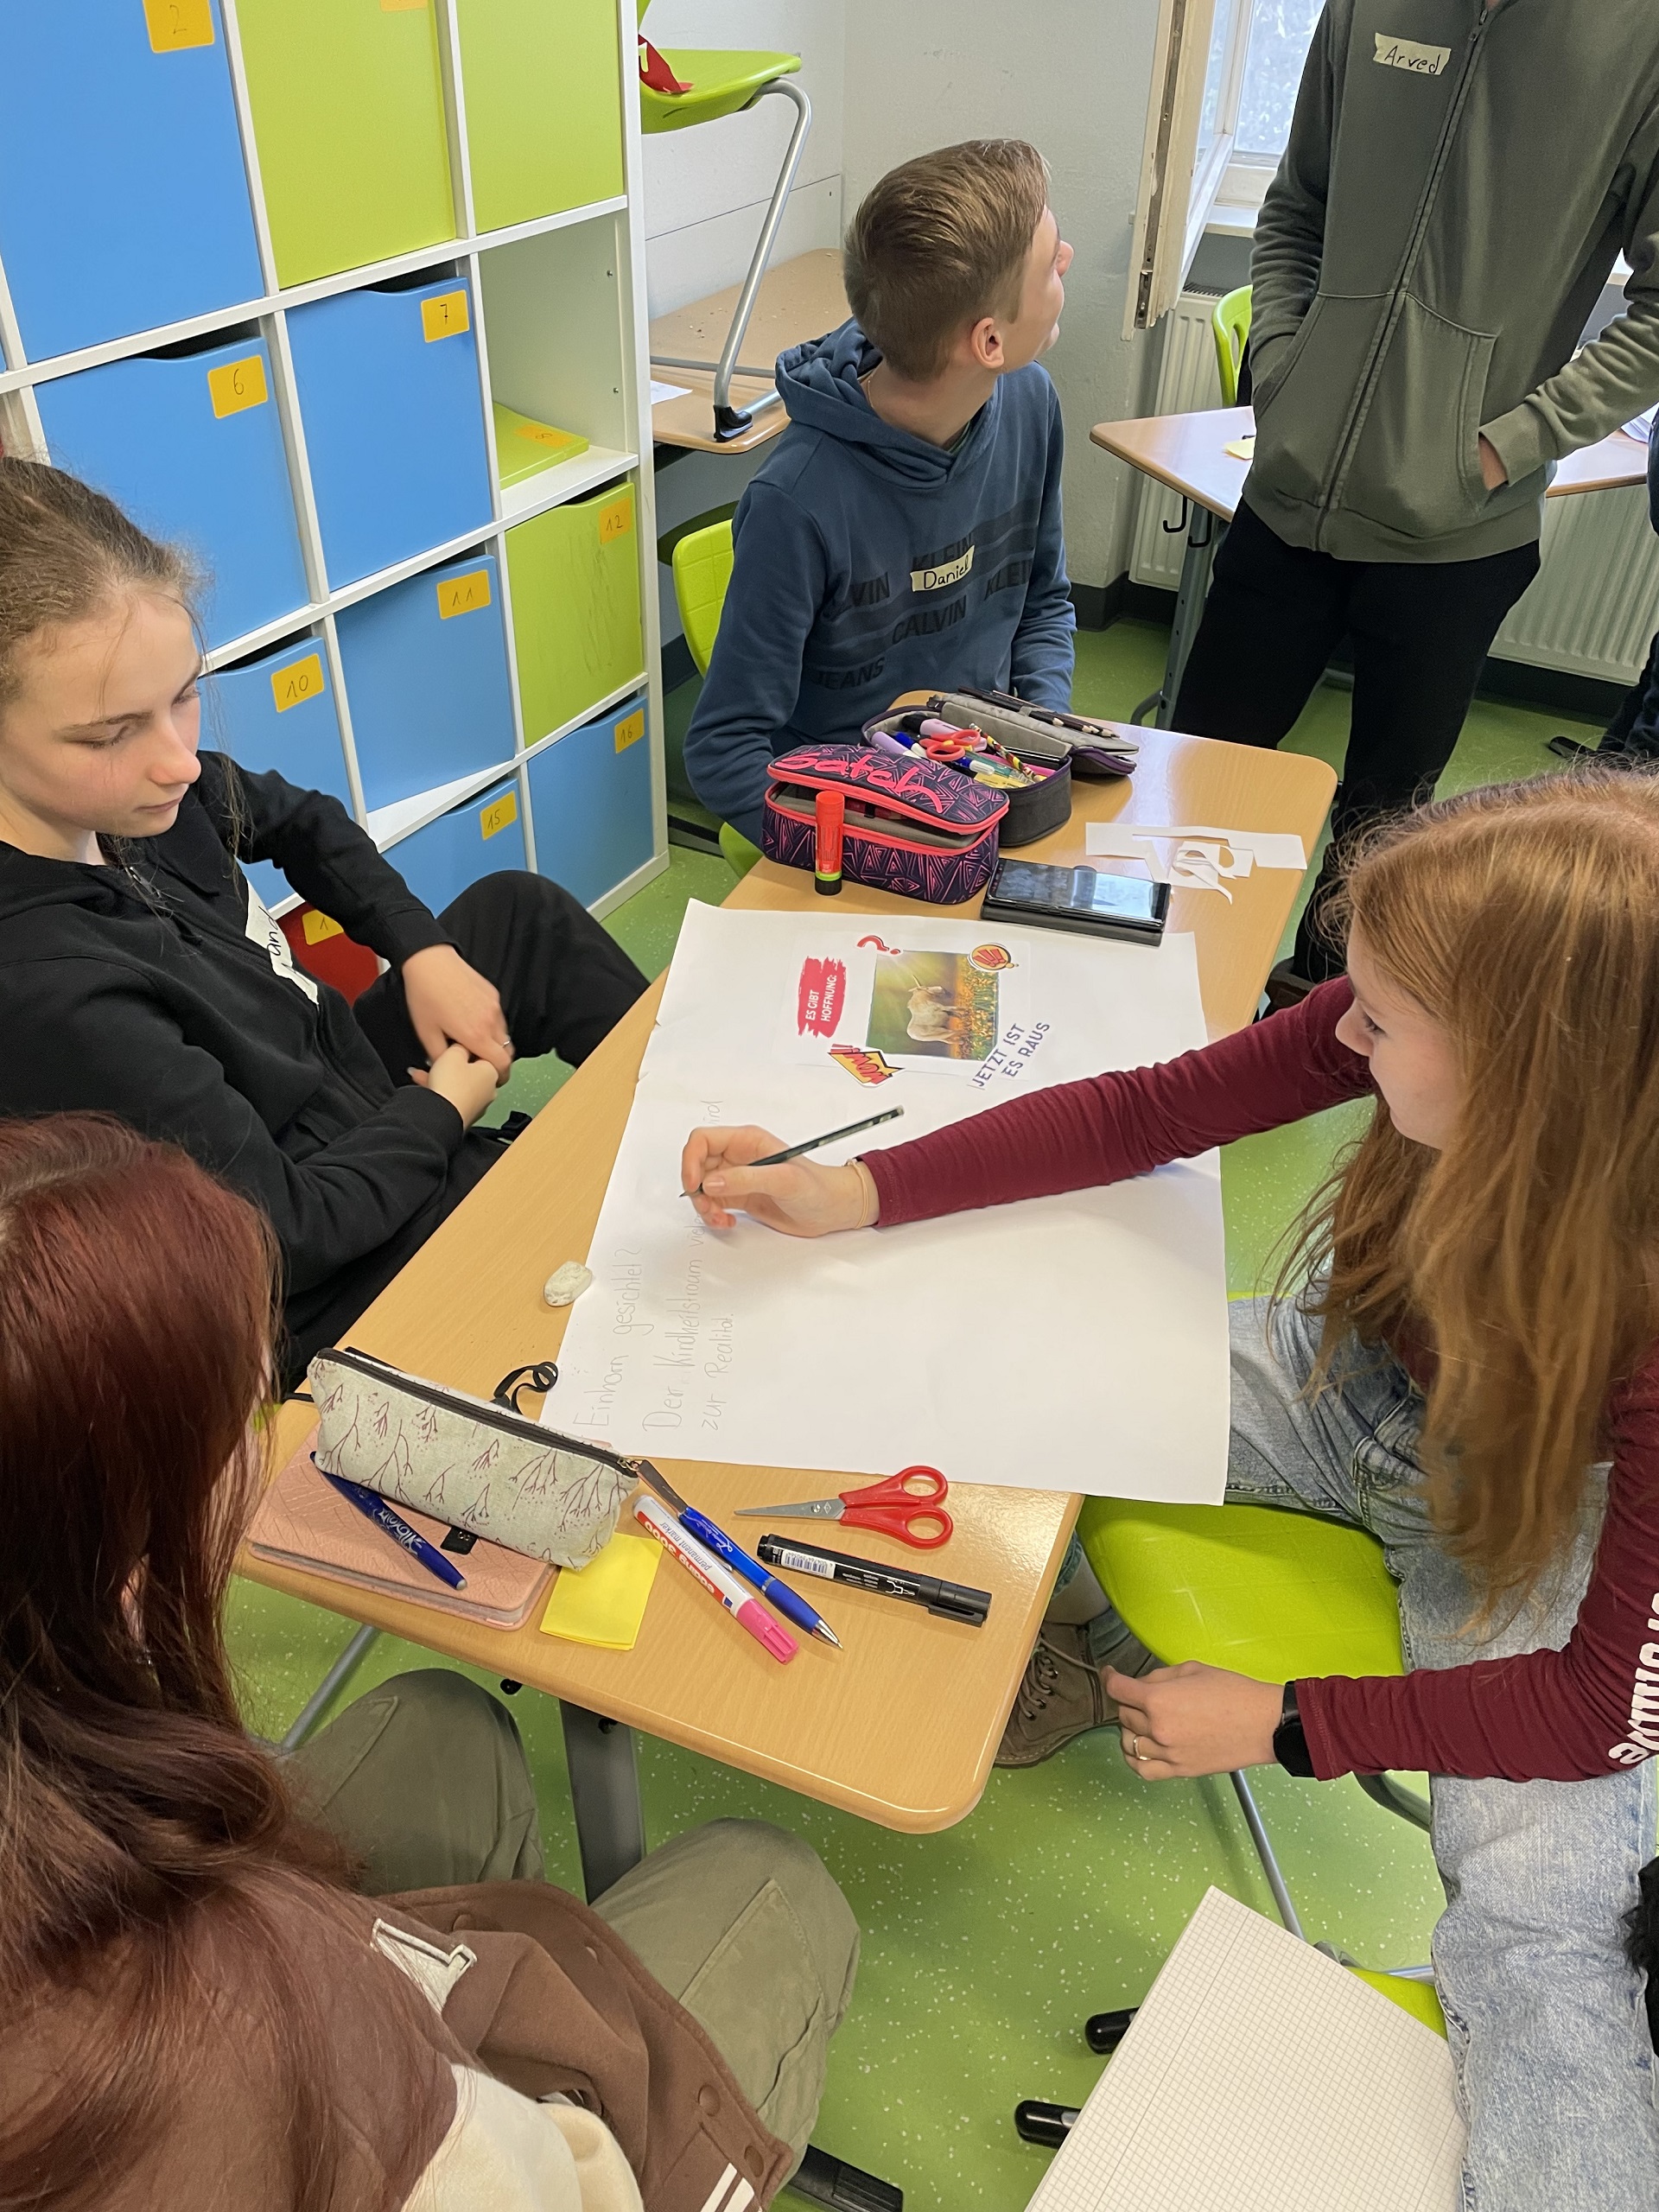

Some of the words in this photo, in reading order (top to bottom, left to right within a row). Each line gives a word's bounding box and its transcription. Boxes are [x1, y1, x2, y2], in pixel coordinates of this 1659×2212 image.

[168, 4, 187, 35] 2
[1384, 45, 1440, 74] Arved
[439, 302, 448, 326] 7
[232, 368, 245, 396] 6
[606, 514, 623, 531] 12
[923, 555, 969, 590] Daniel
[452, 587, 474, 607] 11
[892, 594, 967, 645] CALVIN
[286, 675, 309, 698] 10
[620, 724, 632, 744] 16
[487, 809, 501, 830] 15
[808, 989, 820, 1009] GIBT
[805, 1009, 816, 1021] ES
[972, 1048, 1007, 1087] JETZT
[1003, 1023, 1025, 1046] IST
[1001, 1060, 1024, 1078] ES
[1018, 1021, 1051, 1058] RAUS
[573, 1355, 630, 1426] Einhorn
[642, 1386, 685, 1432] Der
[702, 1394, 728, 1431] zur
[643, 1520, 678, 1555] 3000
[659, 1521, 682, 1543] marker
[678, 1539, 711, 1573] permanent
[676, 1553, 717, 1594] edding
